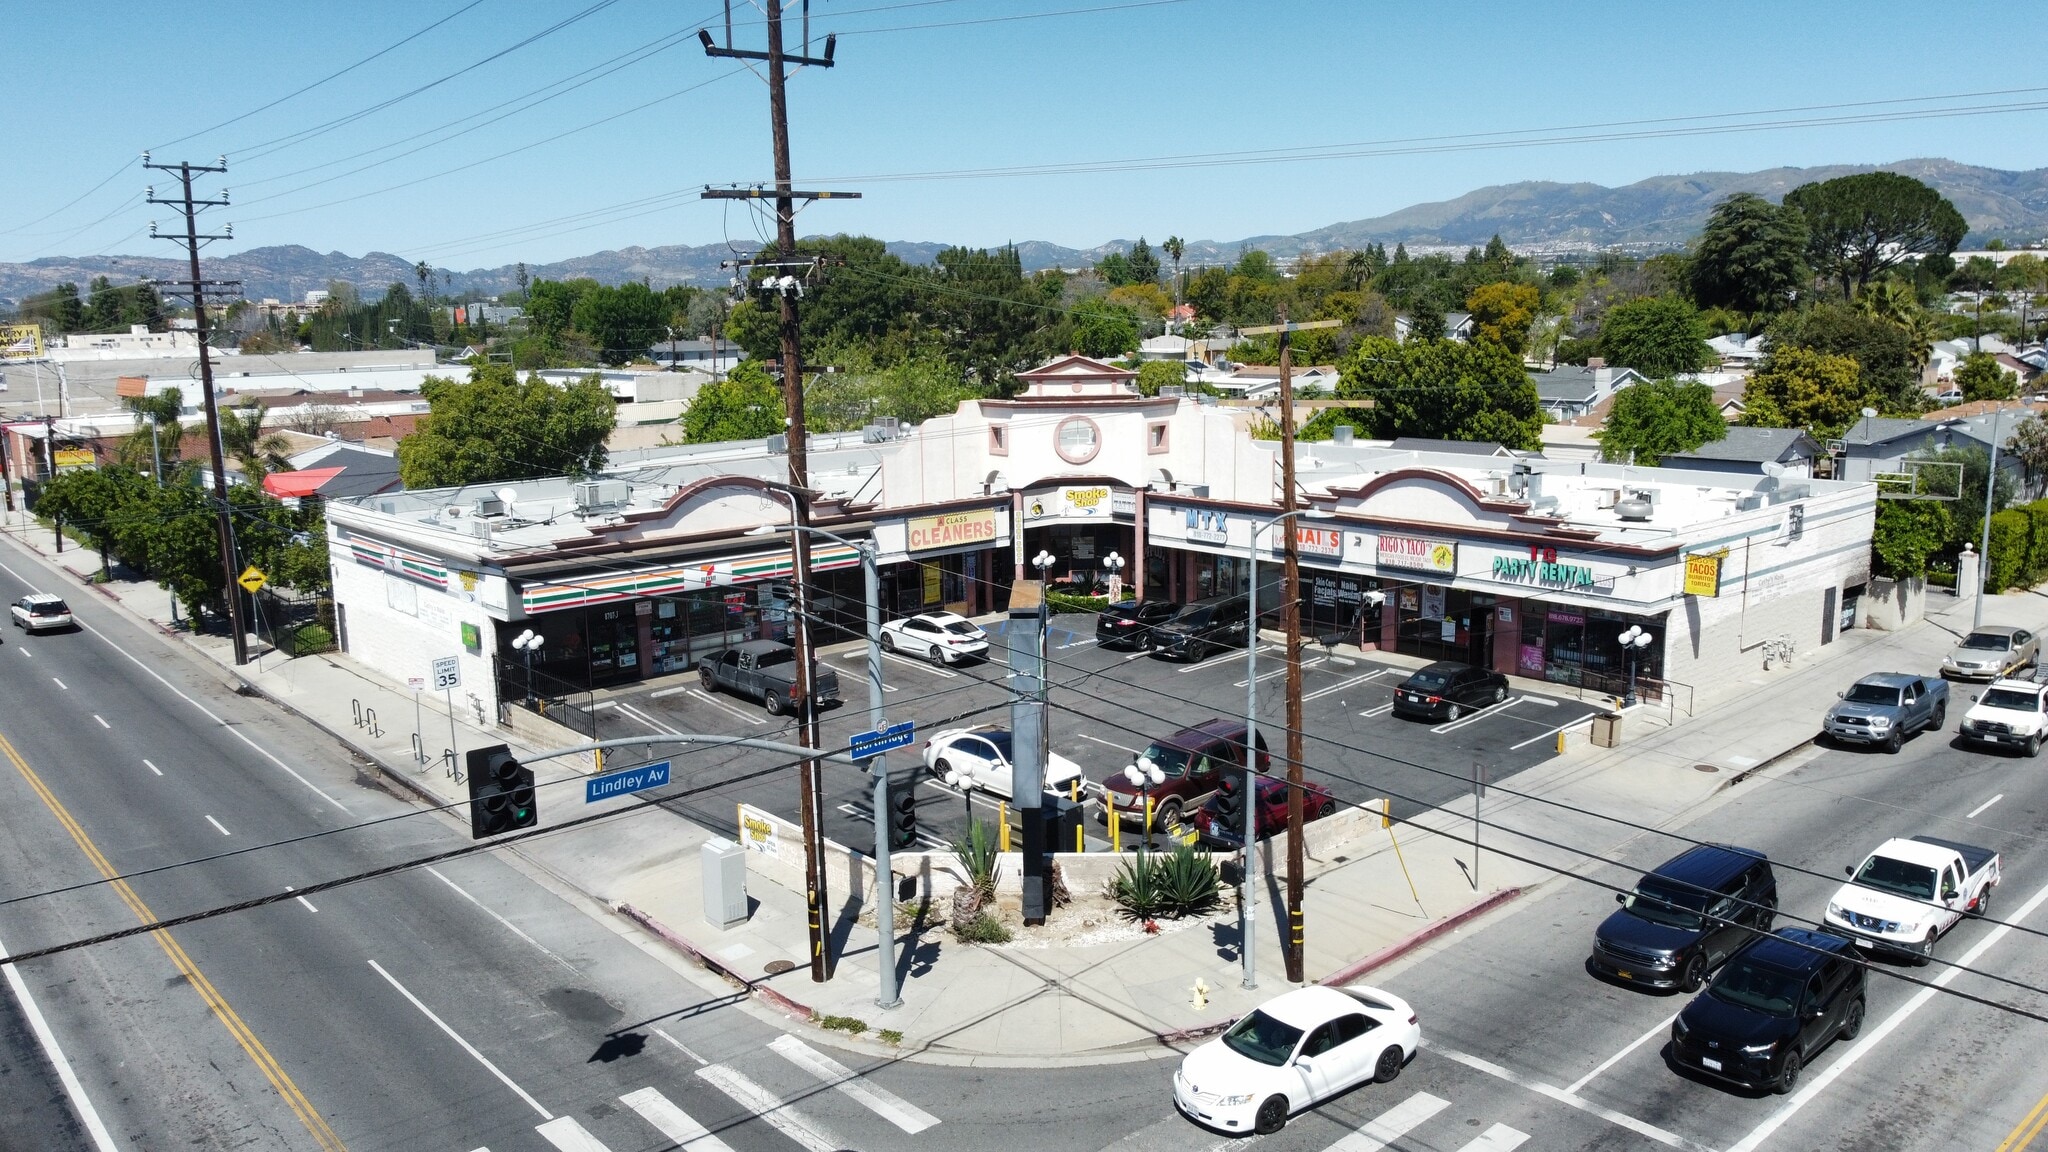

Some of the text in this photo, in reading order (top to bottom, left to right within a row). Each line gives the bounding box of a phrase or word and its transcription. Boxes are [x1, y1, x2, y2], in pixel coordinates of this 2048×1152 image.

[1066, 487, 1107, 501] Smoke
[1074, 498, 1099, 508] Shop
[946, 516, 968, 524] CLASS
[1186, 509, 1227, 531] MTX
[911, 520, 993, 547] CLEANERS
[1407, 538, 1426, 556] TACO
[1493, 555, 1594, 586] PARTY RENTAL
[1689, 563, 1715, 576] TACOS
[1315, 577, 1325, 586] Skin
[1688, 574, 1714, 582] BURRITOS
[1691, 580, 1711, 588] TORTAS
[1314, 585, 1337, 597] Facials
[1341, 580, 1358, 591] Nails
[435, 660, 456, 668] SPEED
[437, 666, 455, 675] LIMIT
[439, 673, 457, 686] 35
[592, 769, 664, 796] Lindley Av
[744, 815, 772, 836] Smoke
